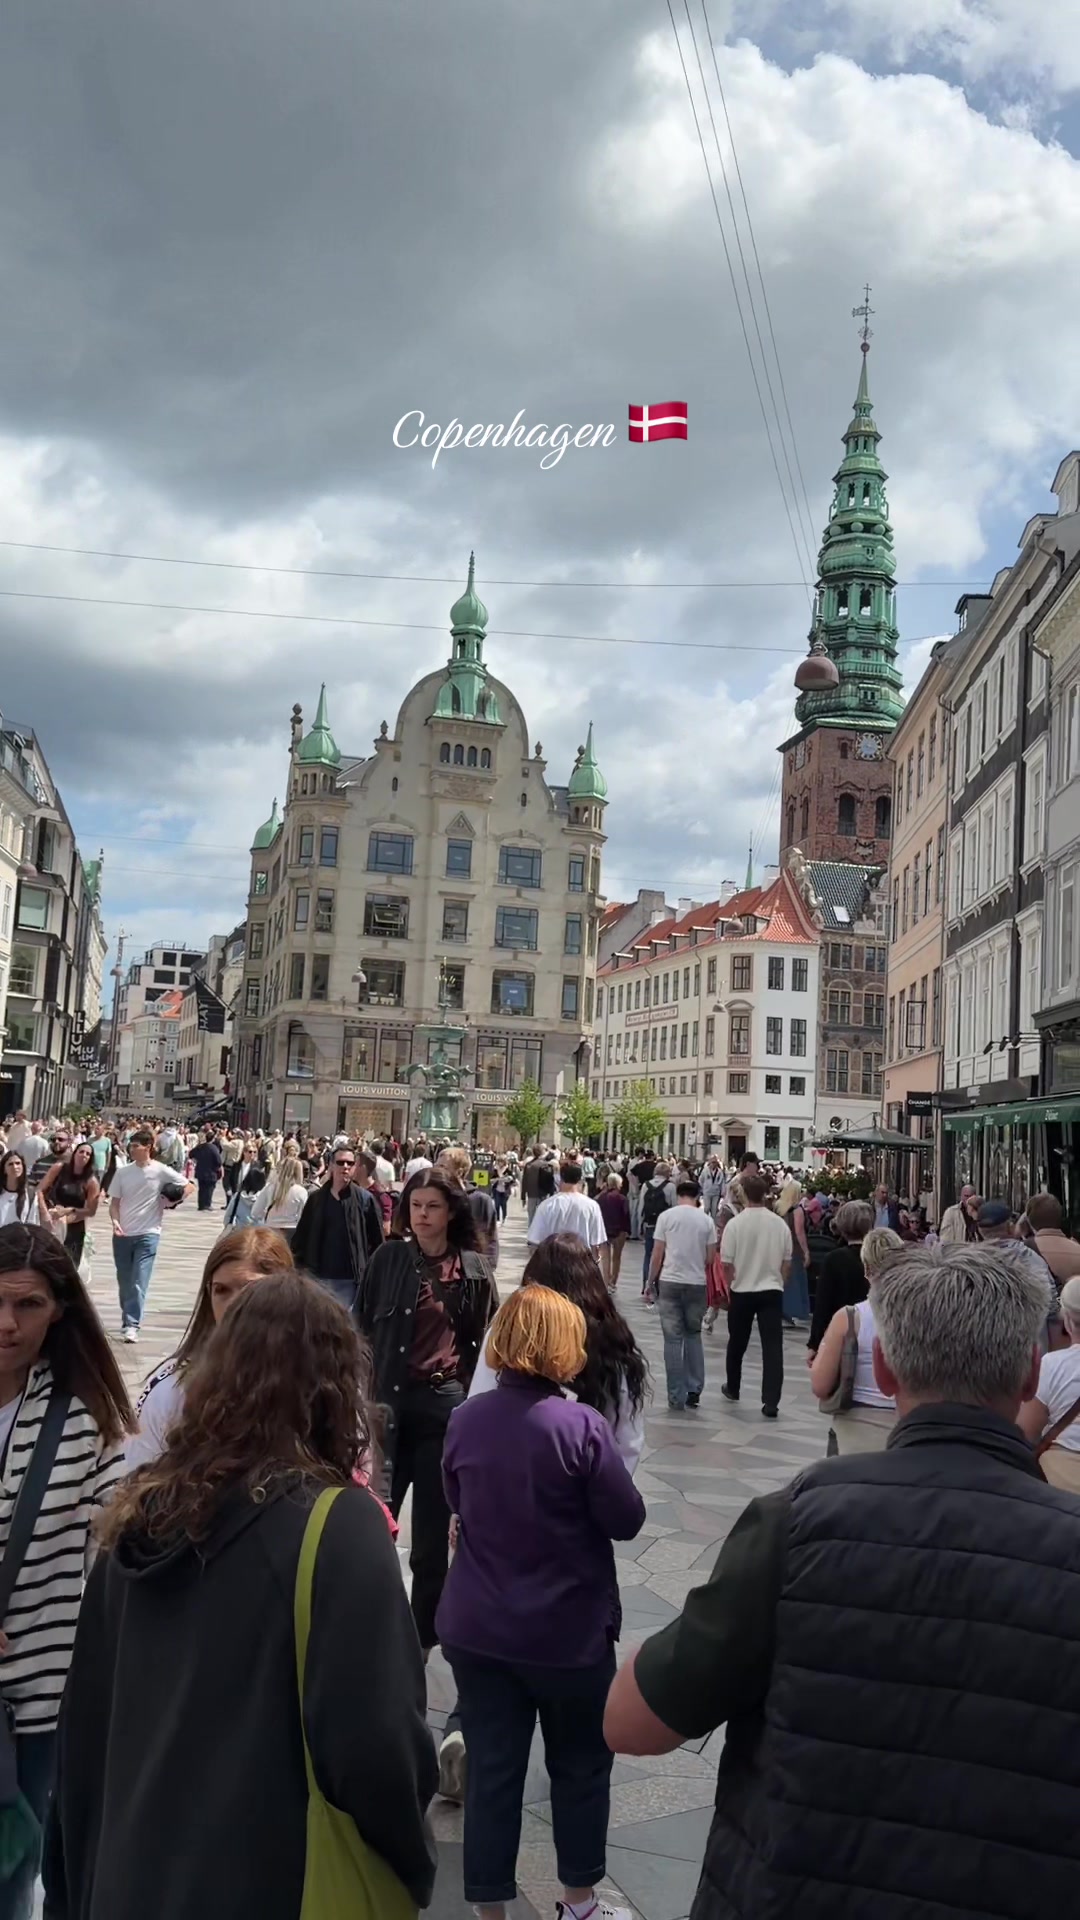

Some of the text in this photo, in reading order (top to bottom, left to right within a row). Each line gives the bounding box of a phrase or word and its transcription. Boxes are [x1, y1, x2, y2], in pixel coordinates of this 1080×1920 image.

[199, 1001, 209, 1030] HAY
[343, 1085, 408, 1097] LOUIS VUITTON
[476, 1092, 501, 1102] LOUIS
